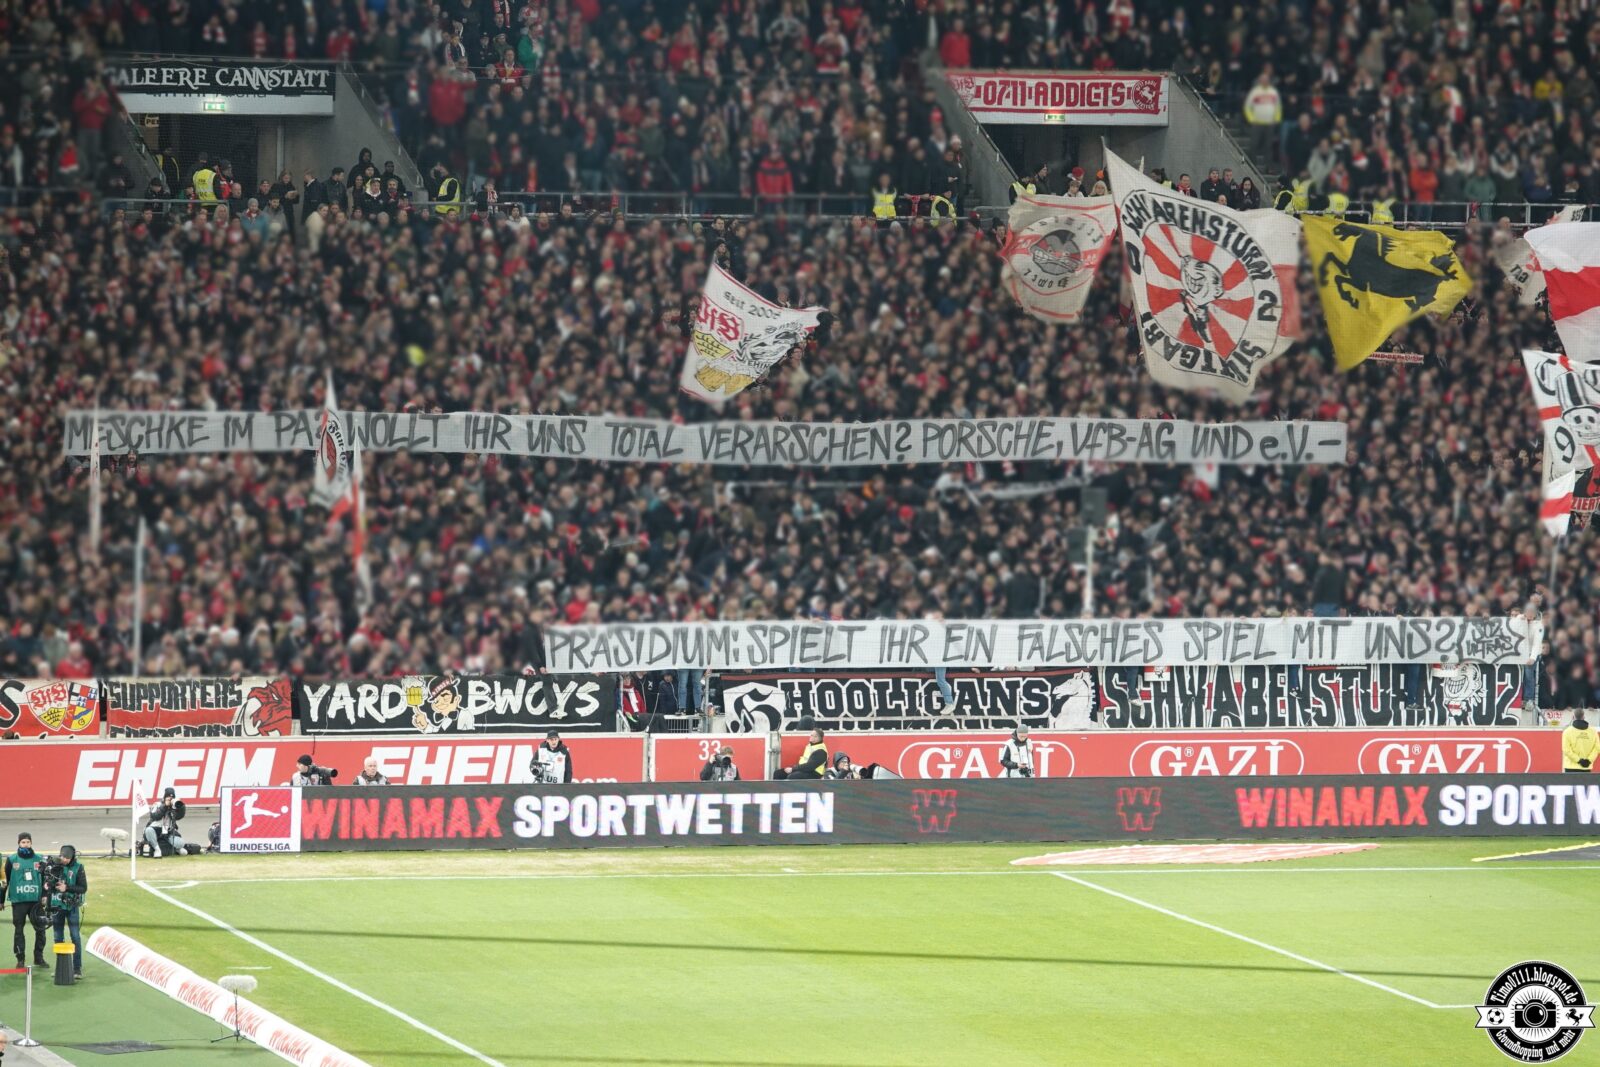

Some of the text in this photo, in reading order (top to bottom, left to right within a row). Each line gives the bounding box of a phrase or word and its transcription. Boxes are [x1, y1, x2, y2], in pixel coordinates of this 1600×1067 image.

[215, 66, 329, 90] CANNSTATT
[984, 80, 1027, 106] 0711
[223, 414, 254, 449] IM
[465, 414, 511, 450] IHR
[526, 418, 587, 455] UNS
[605, 421, 684, 458] TOTAL
[699, 421, 912, 463] VERARSCHEN?
[923, 420, 1063, 460] PORSCHE,
[1191, 423, 1253, 460] UND
[747, 624, 867, 667] SPIELT
[880, 623, 929, 664] IHR
[943, 623, 998, 662] EIN
[1017, 622, 1164, 663] FALSCHES
[1184, 621, 1276, 663] SPIEL
[1292, 619, 1351, 660] MIT
[107, 679, 243, 712] SUPPORTERS
[303, 682, 405, 725] YARD
[778, 677, 1051, 718] HOOLIGANS
[71, 748, 276, 800] EHEIM
[301, 792, 834, 840] WINAMAX SPORTWETTEN
[1235, 786, 1430, 828] WINAMAX
[230, 843, 291, 851] BUNDESLIGA
